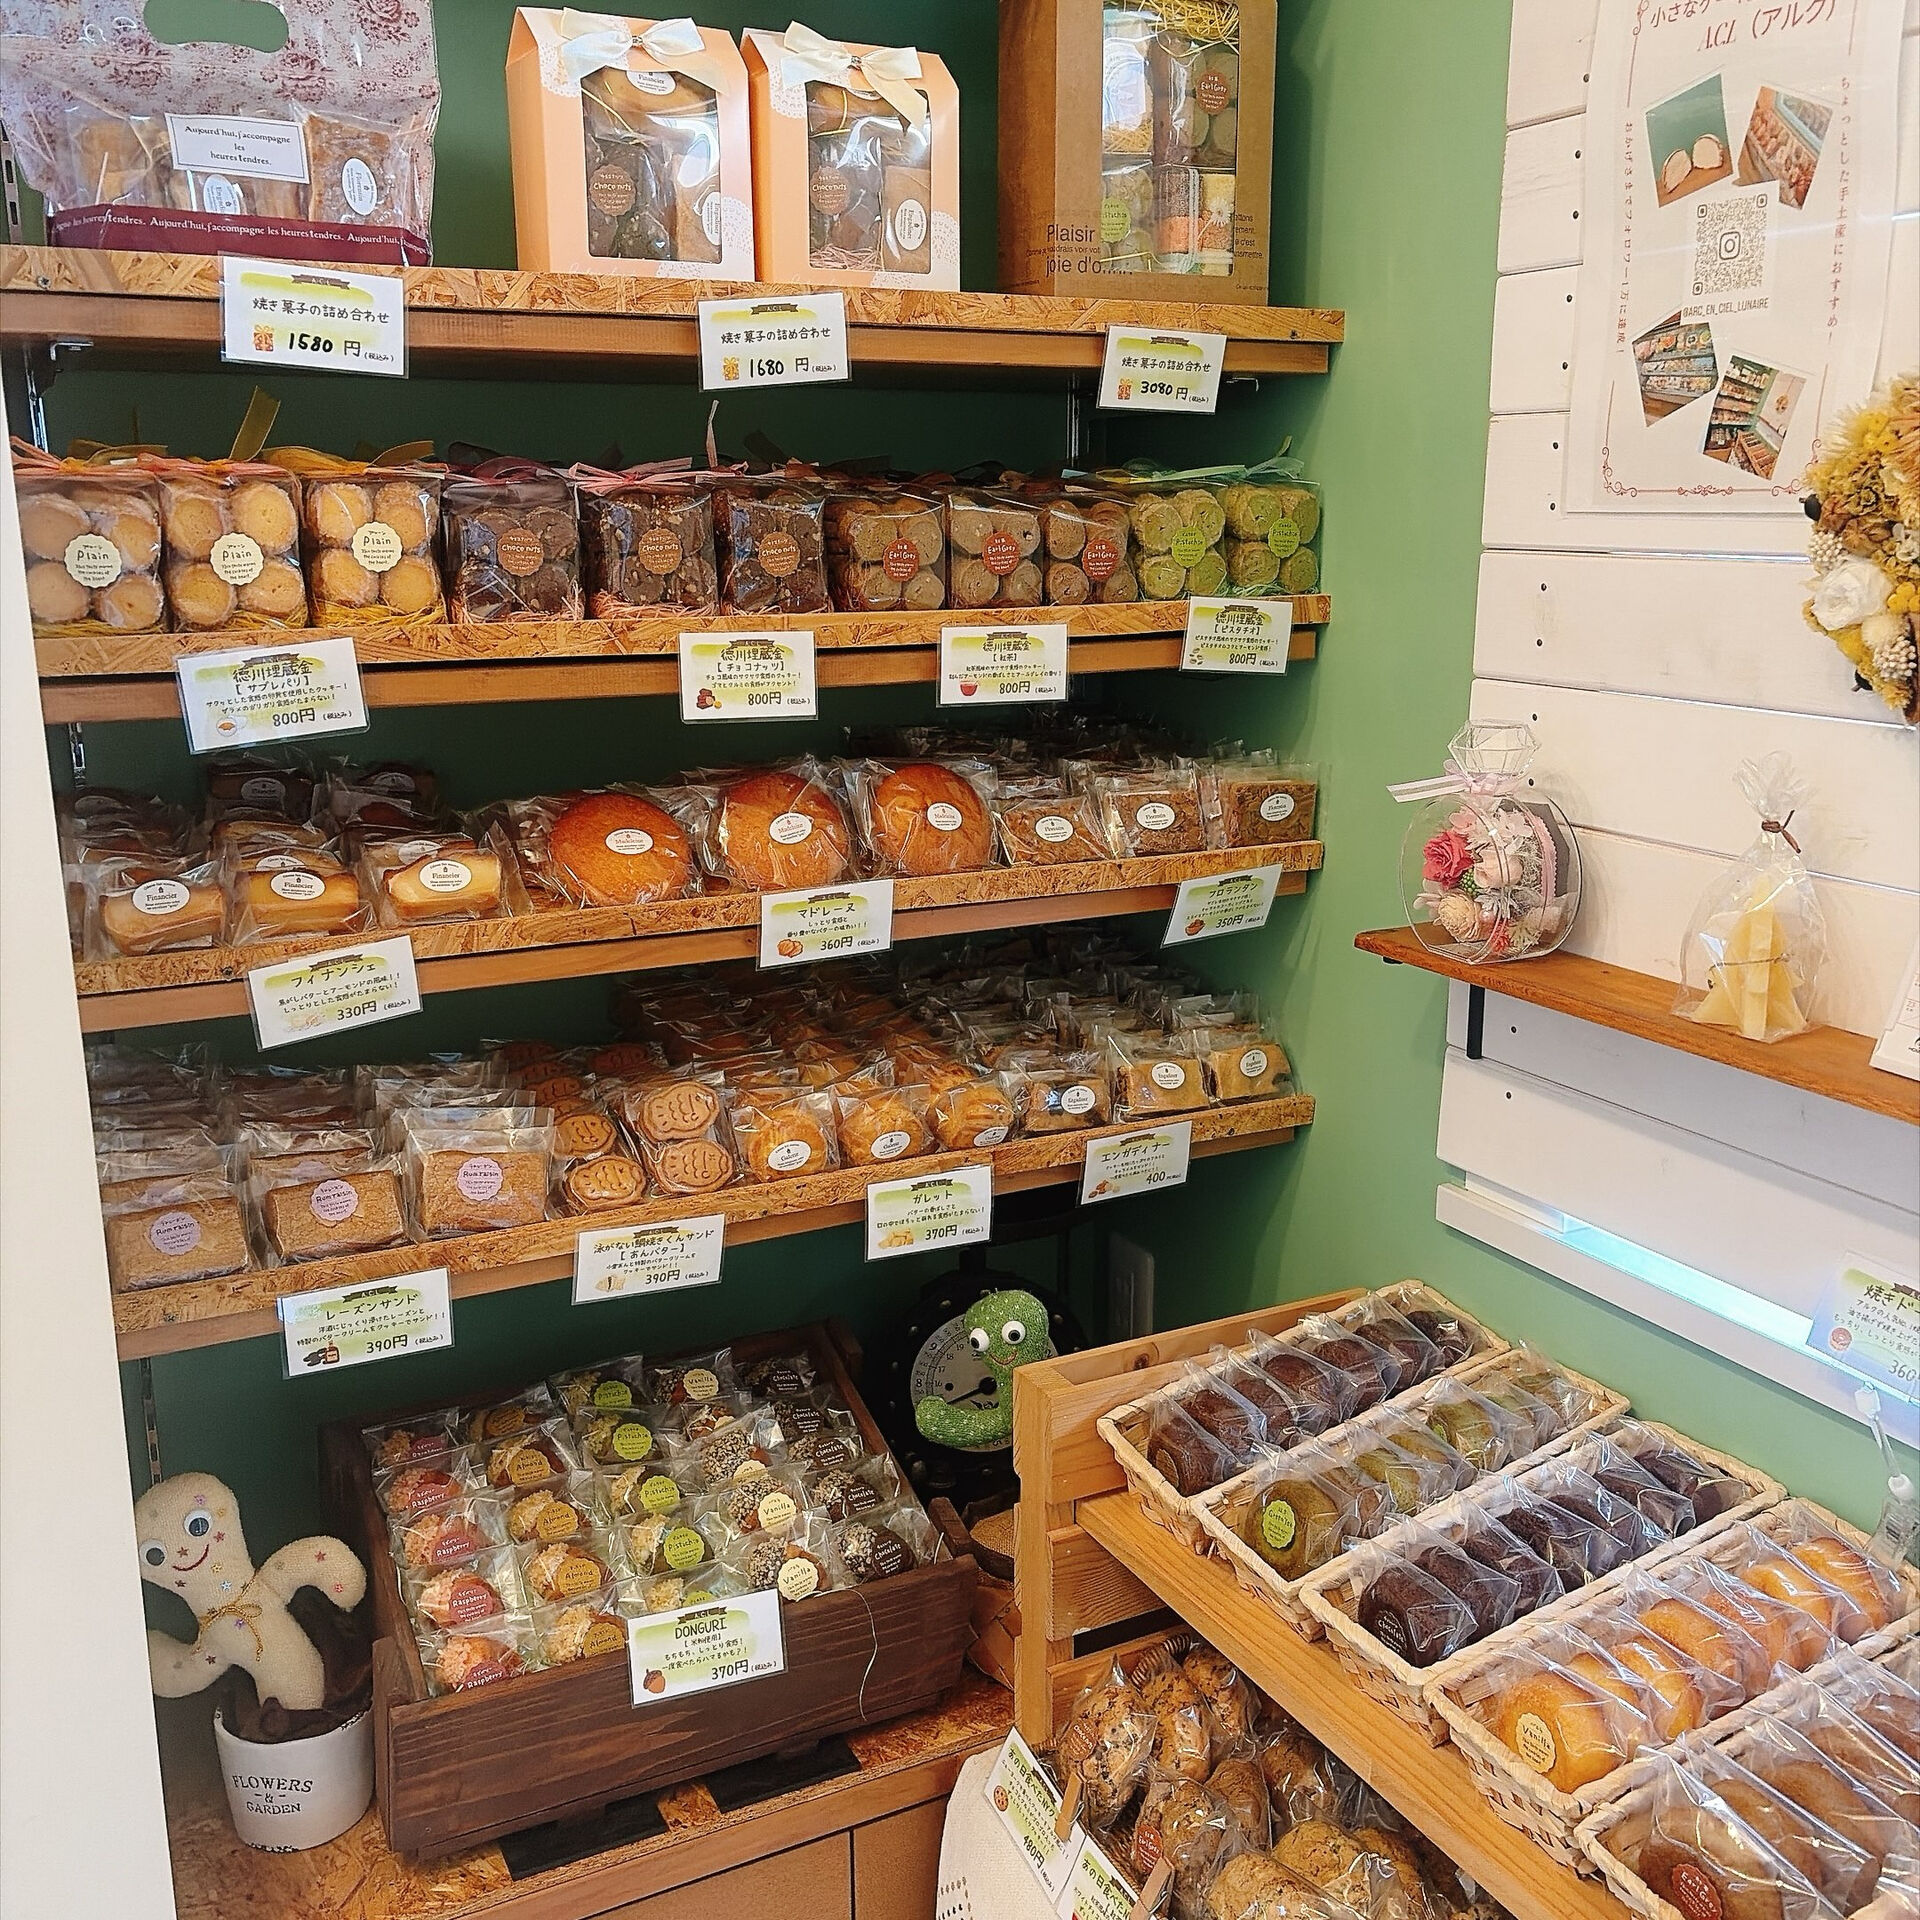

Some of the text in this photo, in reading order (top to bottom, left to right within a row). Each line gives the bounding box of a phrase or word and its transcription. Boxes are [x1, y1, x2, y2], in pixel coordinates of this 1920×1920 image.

[593, 182, 616, 191] Choco
[1047, 224, 1095, 242] Plaisir
[253, 297, 390, 324] 焼き菓子の詰め合わせ
[288, 333, 334, 353] 1580
[721, 327, 832, 345] 焼き菓子の詰め合わせ
[749, 358, 785, 379] 1680
[1121, 356, 1212, 374] 焼き菓子の詰め合わせ
[1140, 380, 1174, 396] 3080
[363, 535, 391, 546] Plain
[642, 543, 679, 553] Choco nuts
[77, 550, 109, 562] Plain
[223, 550, 252, 562] Plain
[501, 544, 541, 554] Choco nuts
[762, 547, 783, 557] Choco
[1229, 653, 1257, 666] 800円
[999, 680, 1031, 694] 800円
[748, 691, 782, 706] 800円
[273, 707, 316, 728] 800円
[284, 882, 314, 891] Financier
[146, 893, 177, 902] Financier
[820, 936, 853, 951] 360円
[337, 1000, 377, 1021] 330円
[913, 1190, 953, 1204] ガレット
[925, 1224, 958, 1241] 370円
[646, 1269, 680, 1285] 390円
[326, 1293, 419, 1321] レーズンサンド
[366, 1334, 408, 1354] 390円
[763, 1502, 791, 1516] Vanilla
[436, 1541, 471, 1558] Raspberry
[782, 1566, 811, 1586] Vanilla
[452, 1593, 488, 1609] Raspberry
[675, 1617, 728, 1640] DONGURI
[711, 1659, 749, 1681] 370円
[467, 1671, 503, 1690] Raspberry
[1522, 1724, 1551, 1751] Vanilla
[232, 1773, 313, 1795] FLOWERS
[246, 1800, 301, 1816] GARDEN
